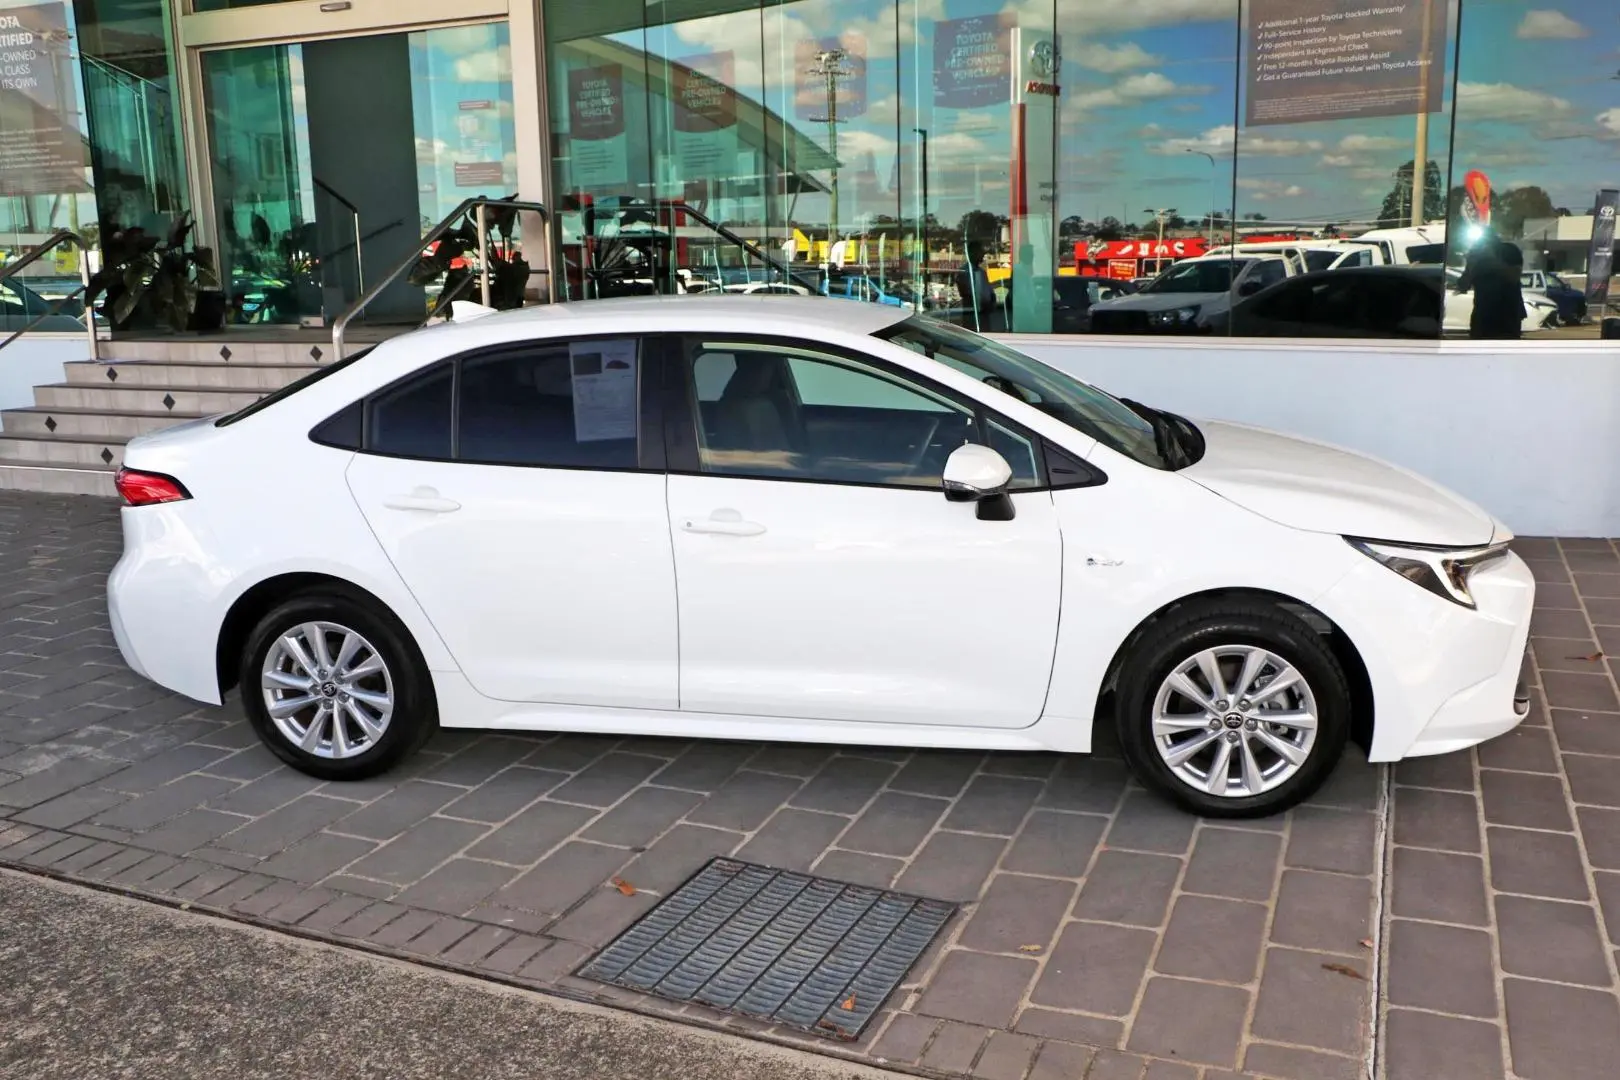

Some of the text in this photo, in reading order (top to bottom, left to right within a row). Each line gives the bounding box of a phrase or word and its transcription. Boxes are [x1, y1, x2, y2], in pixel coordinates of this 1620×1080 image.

[1303, 26, 1327, 34] History
[955, 32, 994, 45] TOYOTA
[1293, 36, 1328, 47] Inspection
[1328, 36, 1338, 44] by
[1338, 33, 1361, 42] Toyota
[1362, 29, 1403, 38] Technicians
[1263, 42, 1369, 61] Independent Background Check
[1314, 57, 1336, 66] Toyota
[1336, 54, 1369, 63] Roadside
[4, 64, 31, 76] CLASS
[1263, 73, 1275, 81] Get
[1281, 69, 1321, 80] Guaranteed
[1365, 63, 1381, 71] with
[1382, 61, 1405, 71] Toyota
[15, 77, 38, 89] OWN
